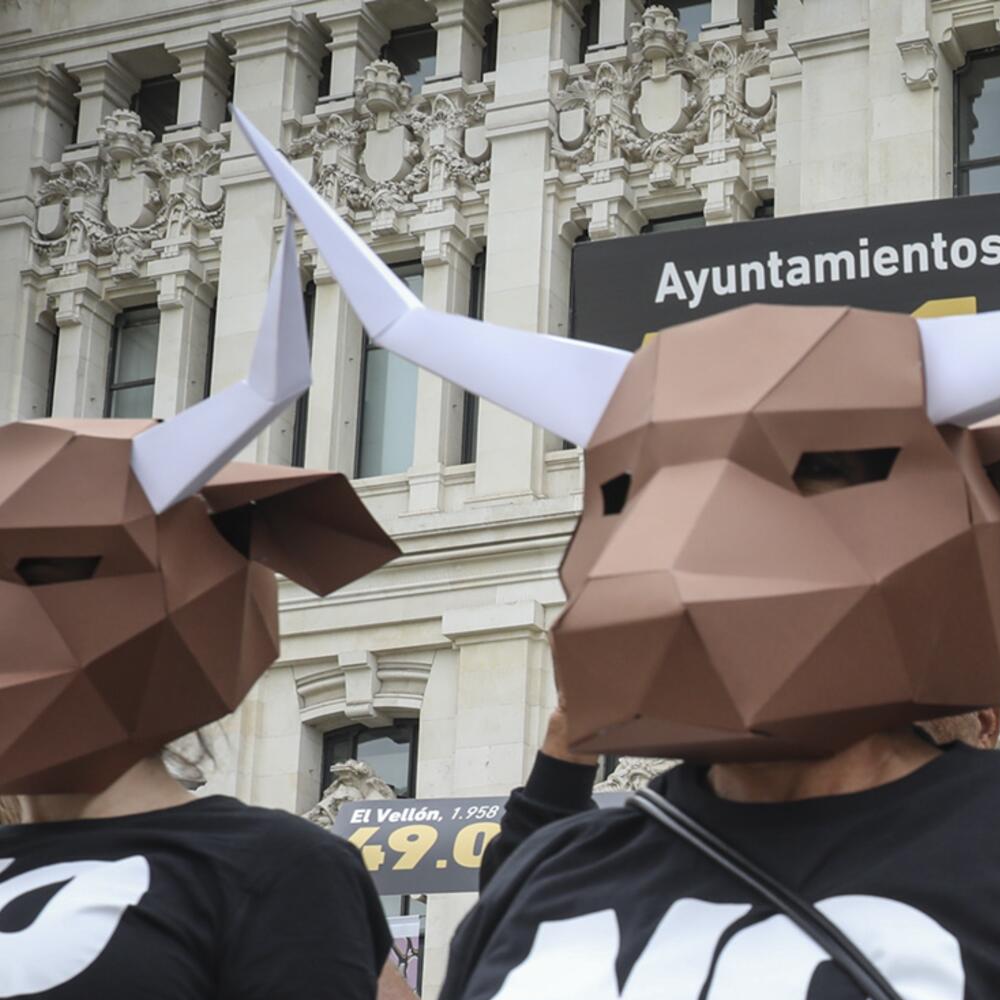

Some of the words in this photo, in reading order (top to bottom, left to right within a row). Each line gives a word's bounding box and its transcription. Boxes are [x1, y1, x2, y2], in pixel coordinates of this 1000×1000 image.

[351, 809, 370, 824] El
[378, 806, 443, 823] Vellón,
[451, 804, 500, 820] 1.958
[349, 822, 502, 872] 49.0
